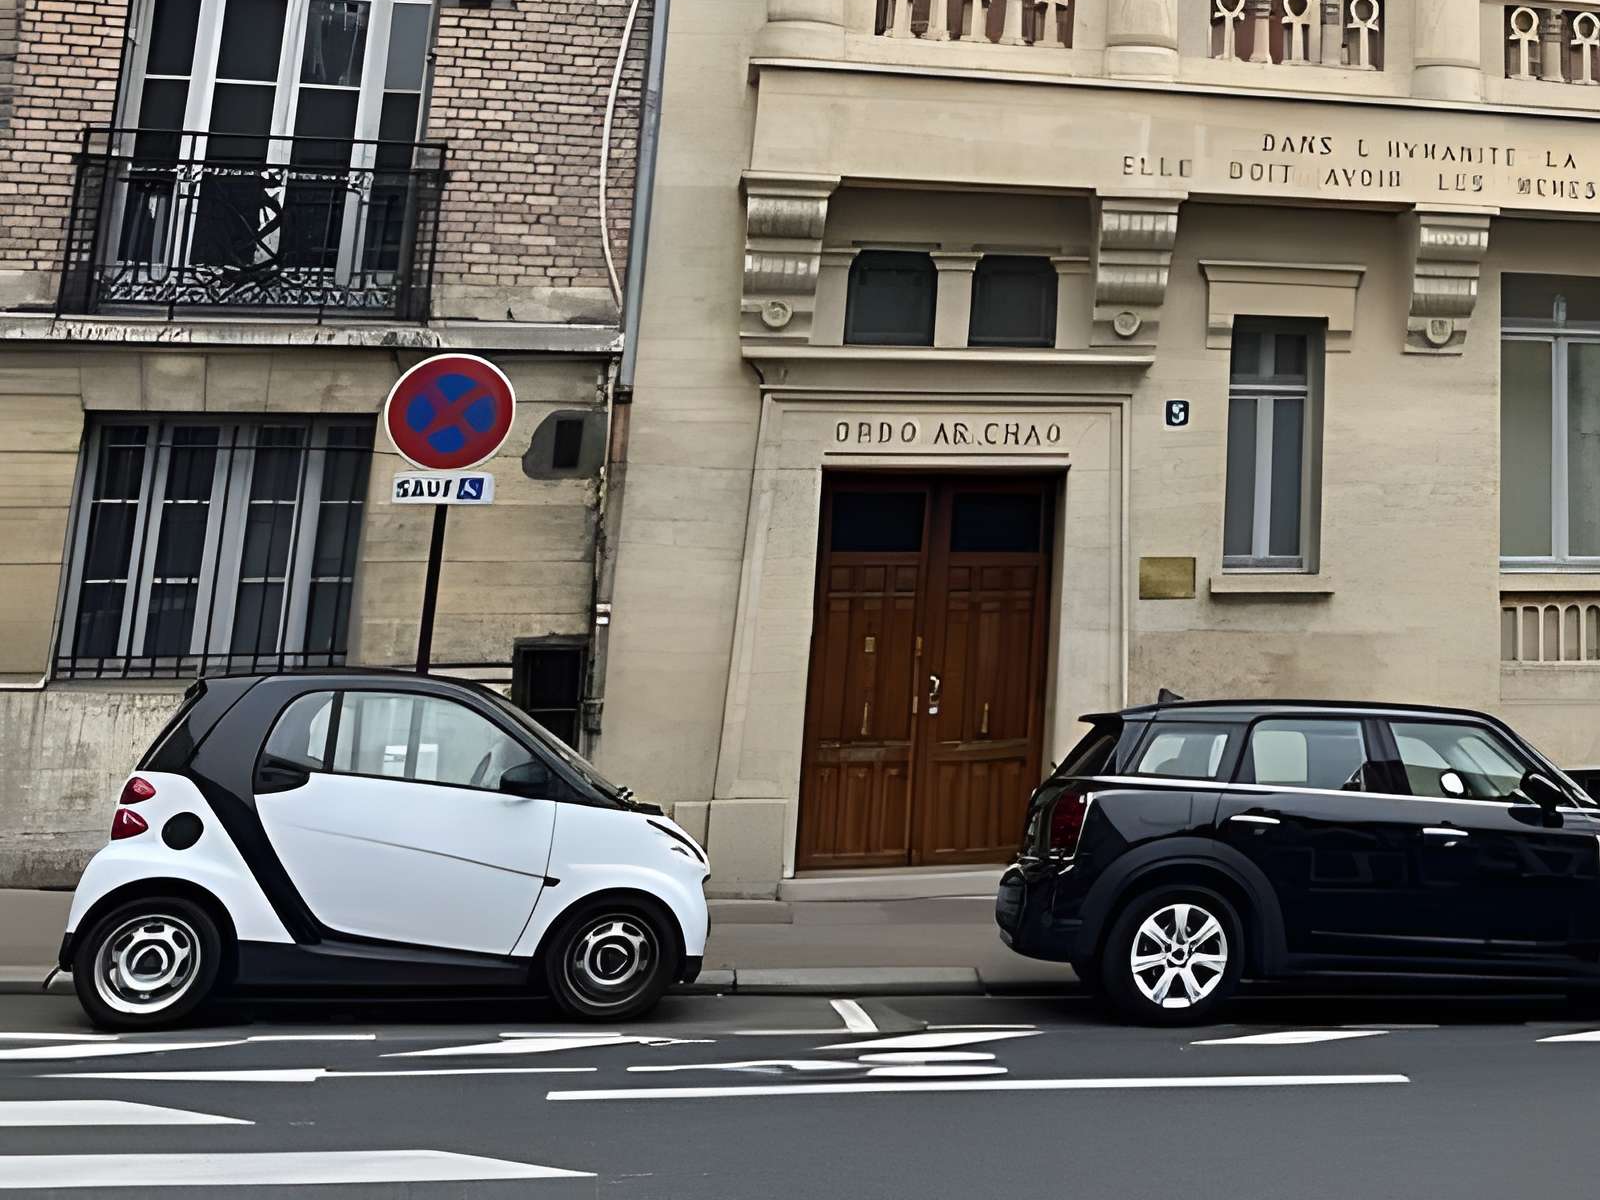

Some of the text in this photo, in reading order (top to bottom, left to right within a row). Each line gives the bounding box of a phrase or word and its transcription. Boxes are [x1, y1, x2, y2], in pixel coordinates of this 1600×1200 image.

[1262, 133, 1333, 155] DANS
[1545, 150, 1577, 170] LA
[1122, 155, 1193, 178] ELLE
[1229, 161, 1294, 184] DOIT
